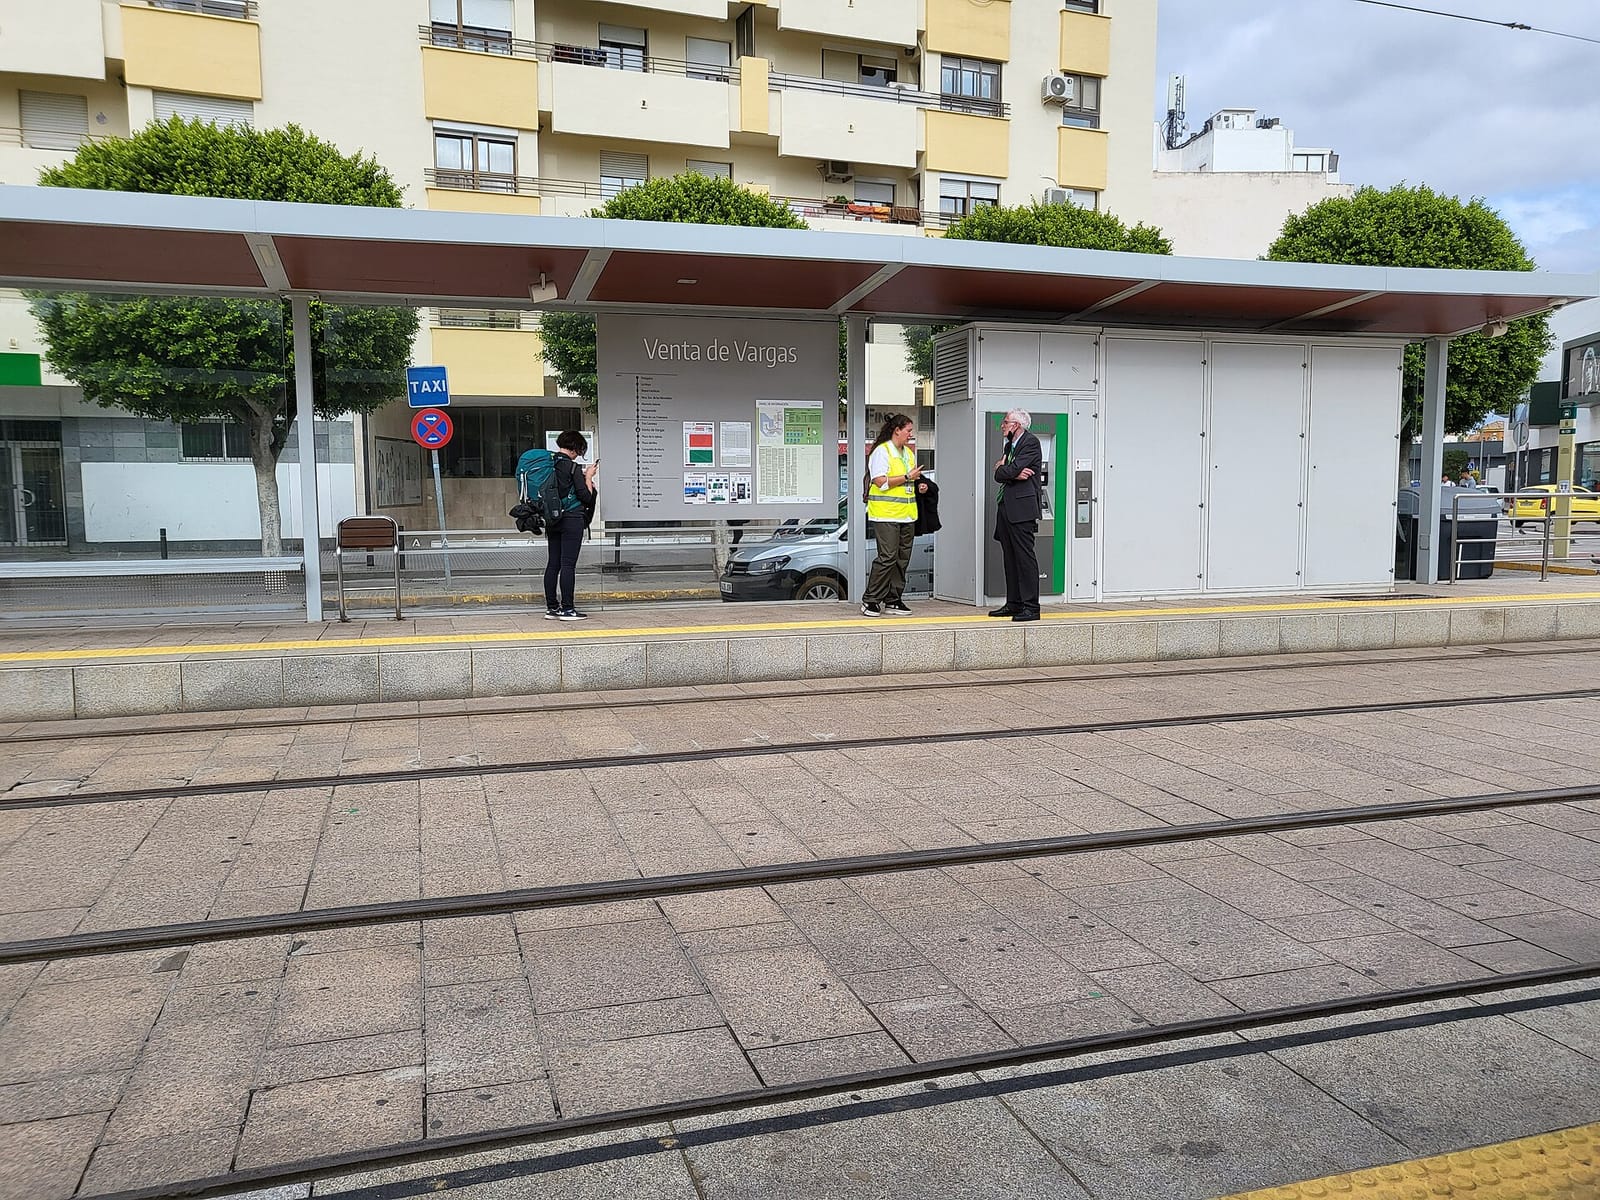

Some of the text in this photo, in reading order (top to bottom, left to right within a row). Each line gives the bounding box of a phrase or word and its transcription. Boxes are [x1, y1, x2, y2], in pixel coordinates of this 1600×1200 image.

[643, 337, 798, 368] Venta de Vargas
[409, 379, 446, 394] TAXI
